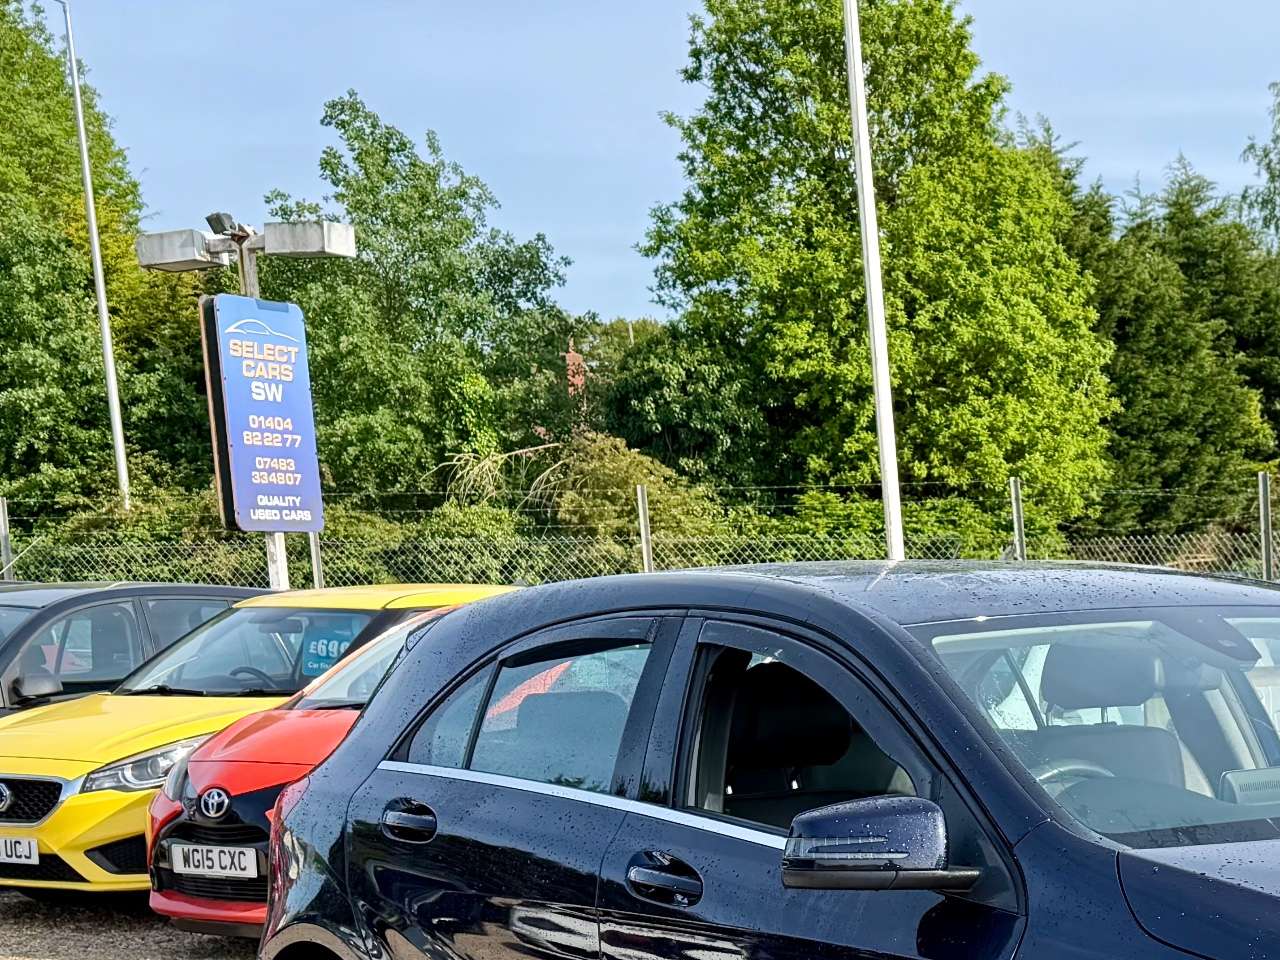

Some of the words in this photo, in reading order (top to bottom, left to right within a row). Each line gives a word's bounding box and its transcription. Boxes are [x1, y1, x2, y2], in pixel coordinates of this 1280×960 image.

[229, 339, 300, 363] SELECT
[242, 360, 293, 381] CARS
[251, 381, 283, 402] SW
[248, 414, 293, 431] 01404
[255, 456, 295, 471] 07483
[251, 471, 301, 485] 334807
[257, 494, 301, 507] QUALITY
[250, 508, 280, 520] USED
[282, 509, 311, 521] CARS
[4, 839, 32, 860] UCJ
[182, 847, 215, 870] WG15
[218, 849, 247, 872] CXC
